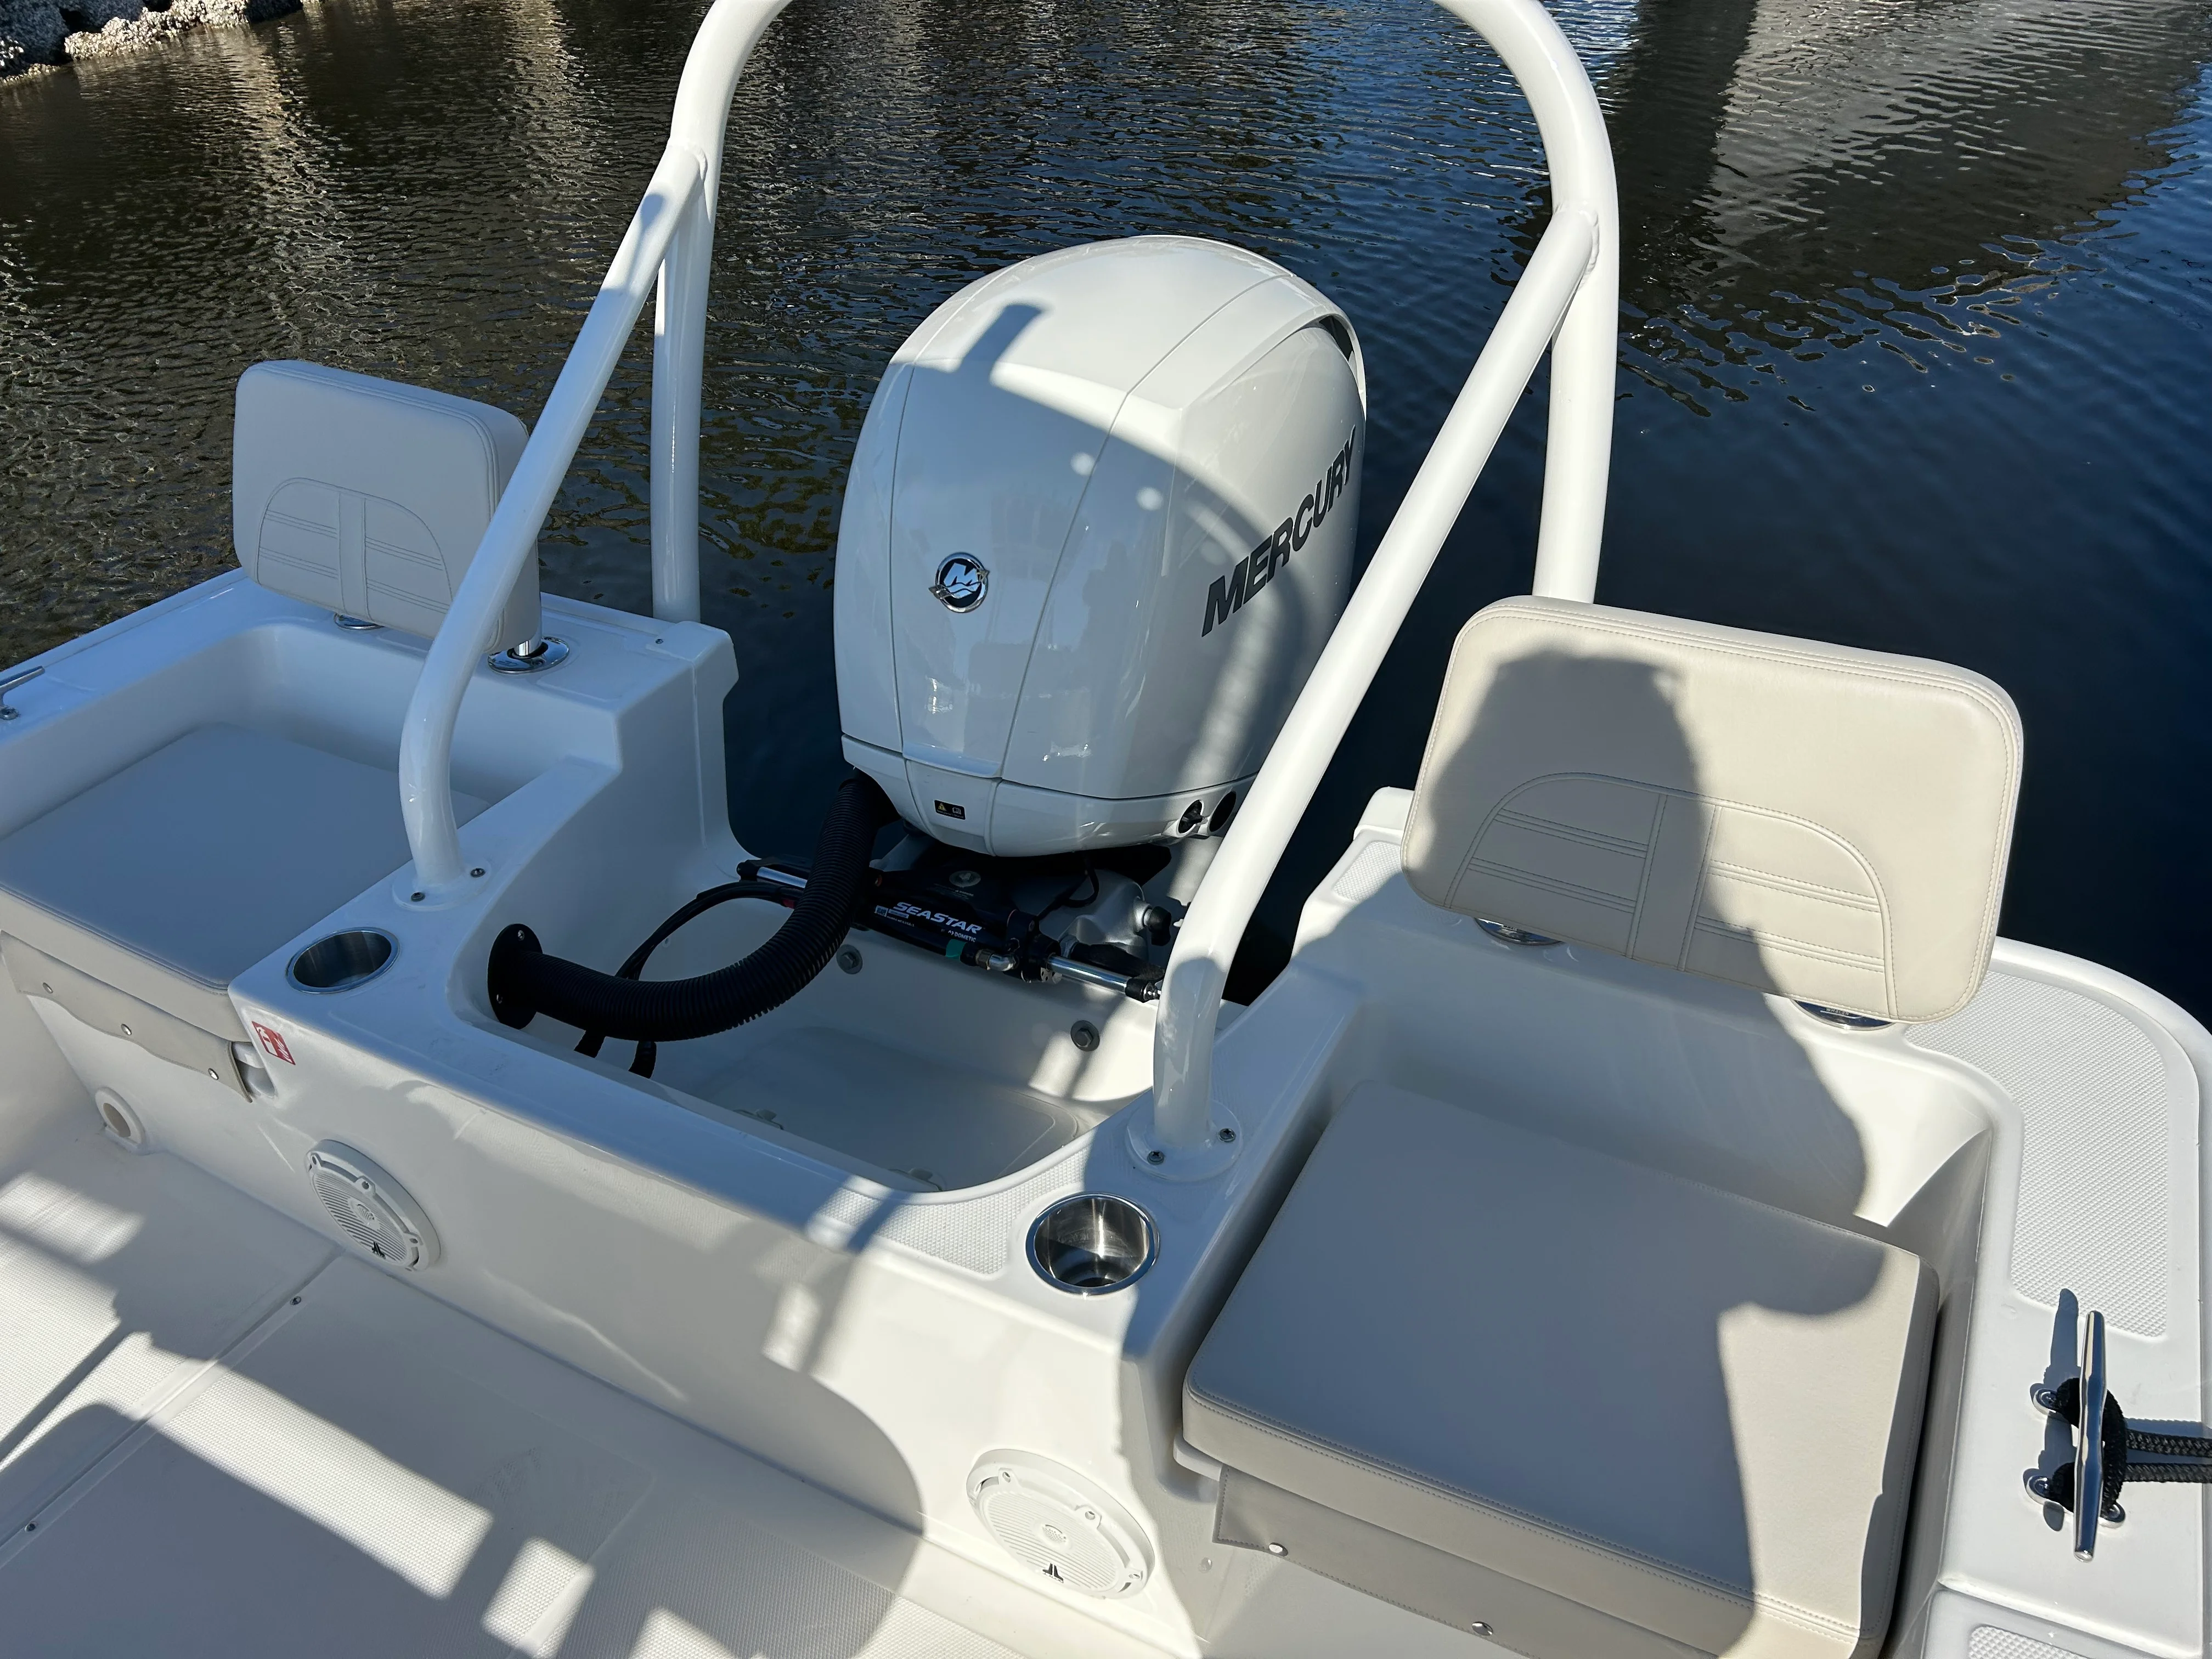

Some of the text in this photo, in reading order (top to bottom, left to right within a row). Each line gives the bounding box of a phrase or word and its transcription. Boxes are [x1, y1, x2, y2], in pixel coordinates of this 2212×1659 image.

[1201, 424, 1356, 637] MERCURY
[893, 901, 982, 934] SEASTAR
[954, 931, 977, 943] DOMETIC
